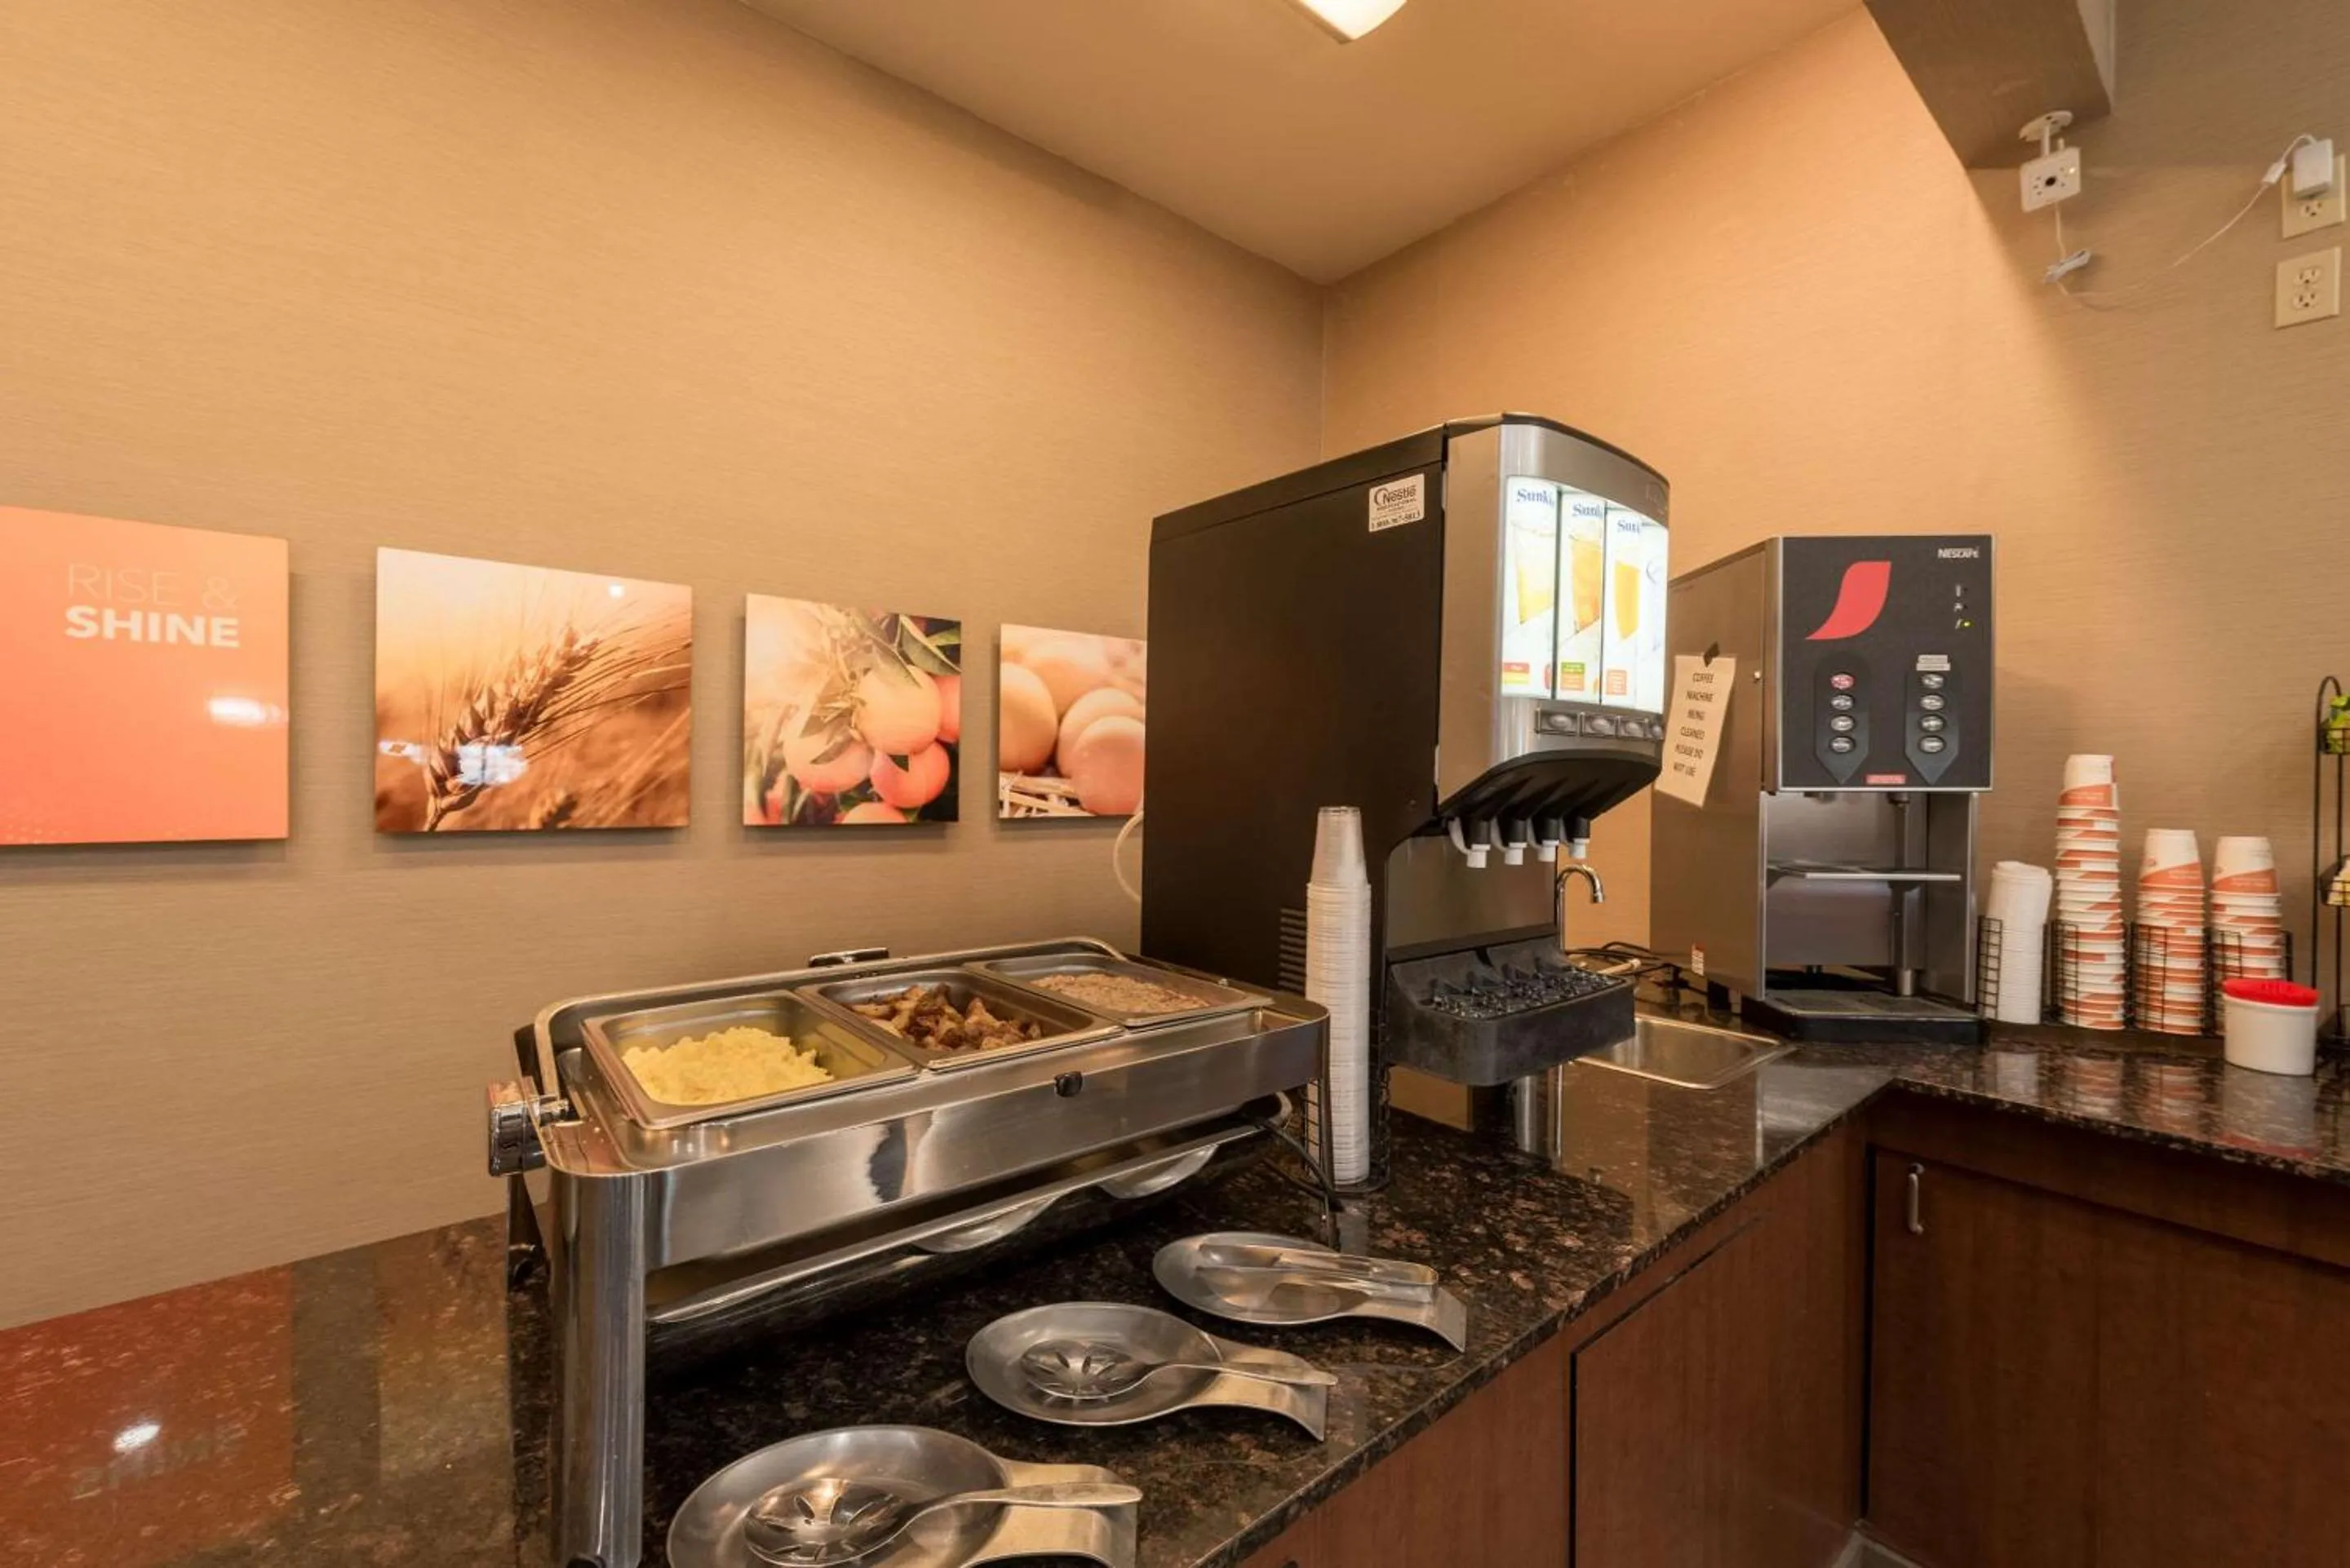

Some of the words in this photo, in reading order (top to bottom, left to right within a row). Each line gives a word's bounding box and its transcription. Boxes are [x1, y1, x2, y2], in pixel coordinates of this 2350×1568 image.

[68, 563, 181, 607] RISE
[202, 575, 238, 611] &
[64, 604, 241, 649] SHINE
[1692, 672, 1714, 684] COFFEE
[1686, 690, 1714, 702] MACHINE
[1680, 726, 1705, 740] CLEANED
